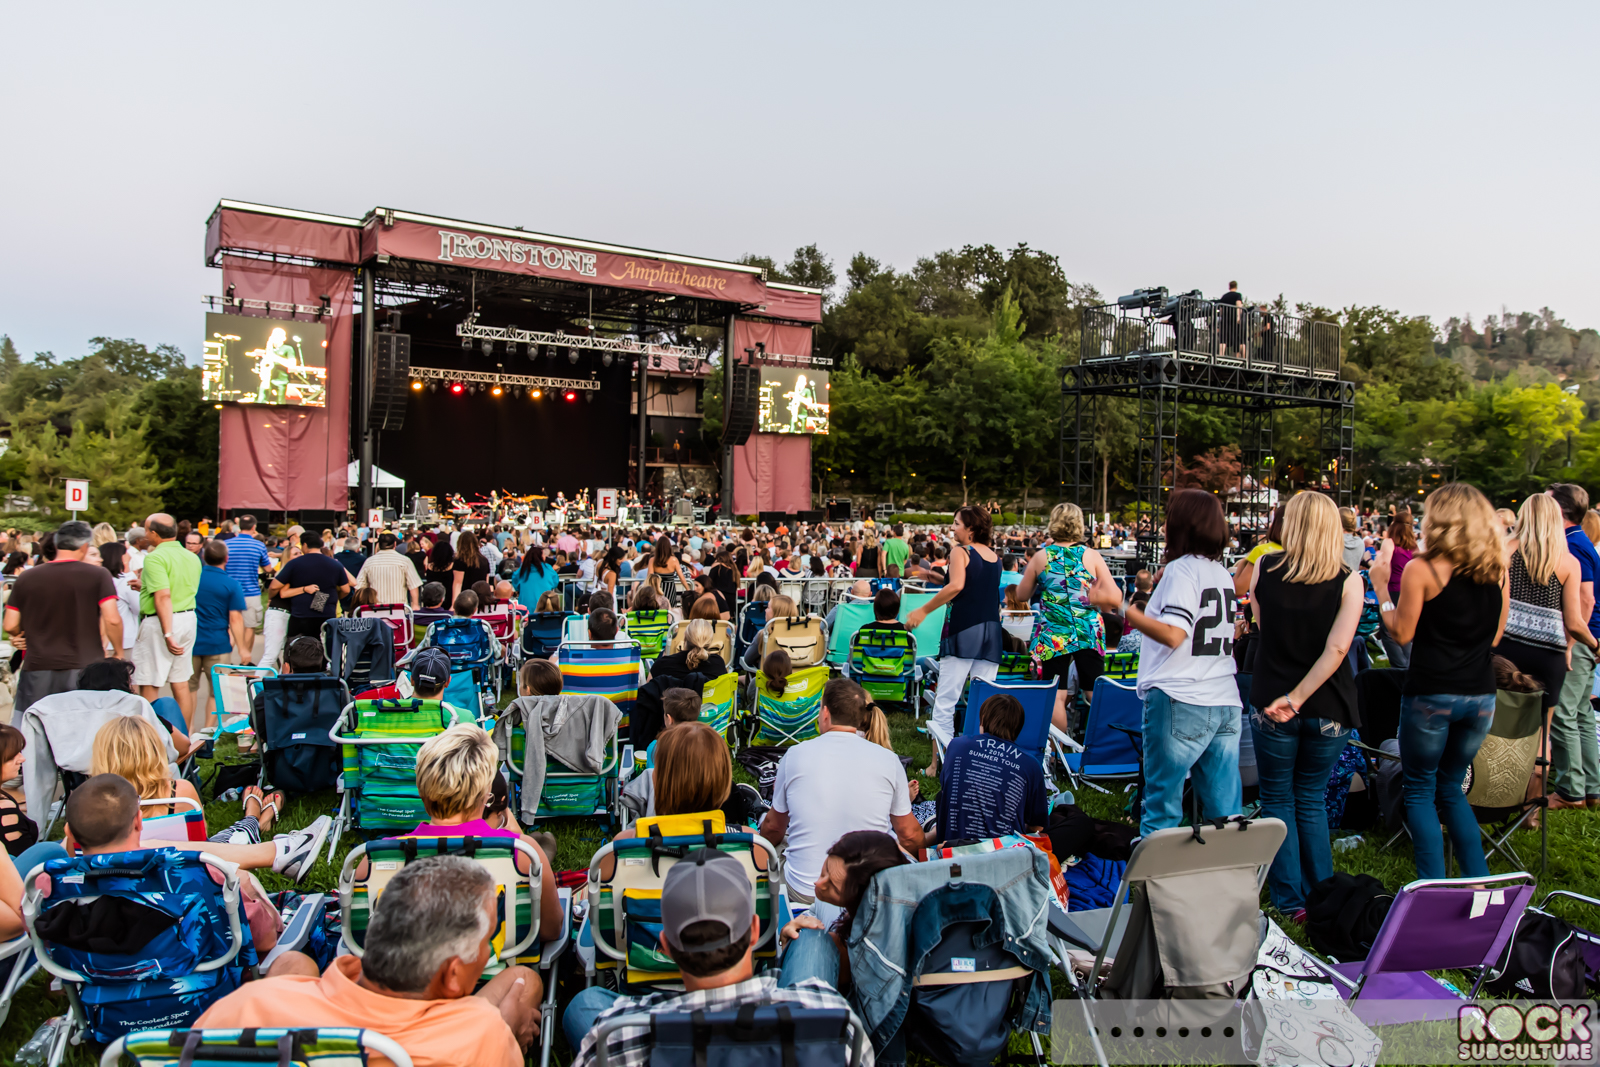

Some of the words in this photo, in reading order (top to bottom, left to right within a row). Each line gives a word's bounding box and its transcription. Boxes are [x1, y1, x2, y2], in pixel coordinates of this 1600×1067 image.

[438, 230, 597, 278] IRONSTONE
[609, 261, 727, 291] Amphitheatre
[72, 488, 82, 502] D
[602, 496, 611, 509] E
[372, 514, 379, 523] A
[534, 516, 540, 524] B
[975, 738, 1023, 759] TRAIN
[988, 748, 1004, 758] 2016
[968, 749, 999, 763] SUMMER
[1001, 758, 1021, 771] TOUR
[1514, 982, 1535, 994] adidas
[137, 1014, 170, 1025] Coolest
[170, 1010, 190, 1020] Spot
